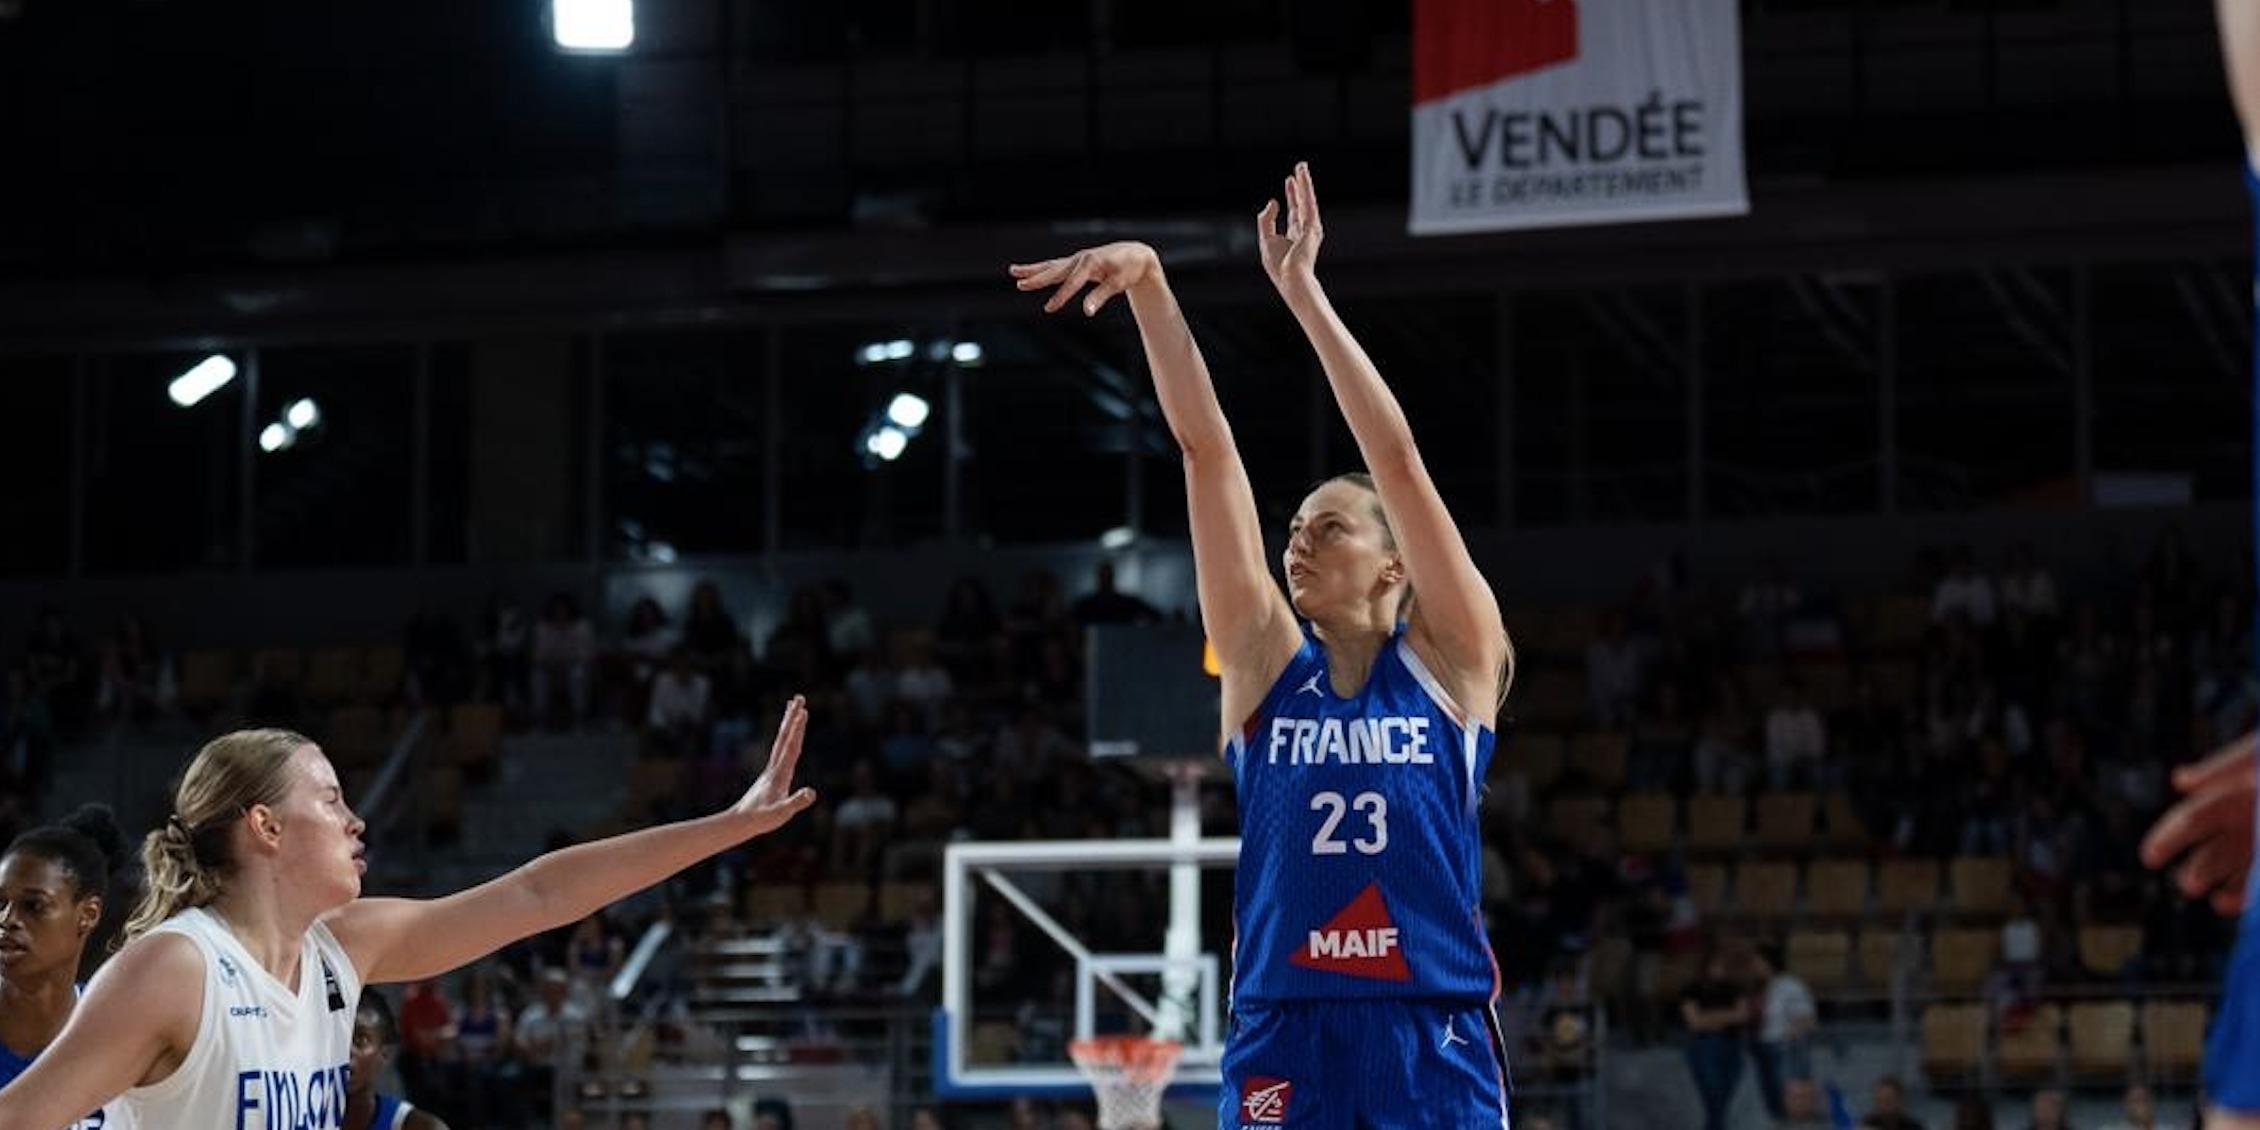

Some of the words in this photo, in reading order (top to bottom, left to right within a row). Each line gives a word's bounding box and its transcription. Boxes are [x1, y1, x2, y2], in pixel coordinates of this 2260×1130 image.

[1451, 179, 1484, 208] LE
[1268, 717, 1434, 764] FRANCE
[1310, 791, 1389, 855] 23
[1310, 928, 1399, 959] MAIF
